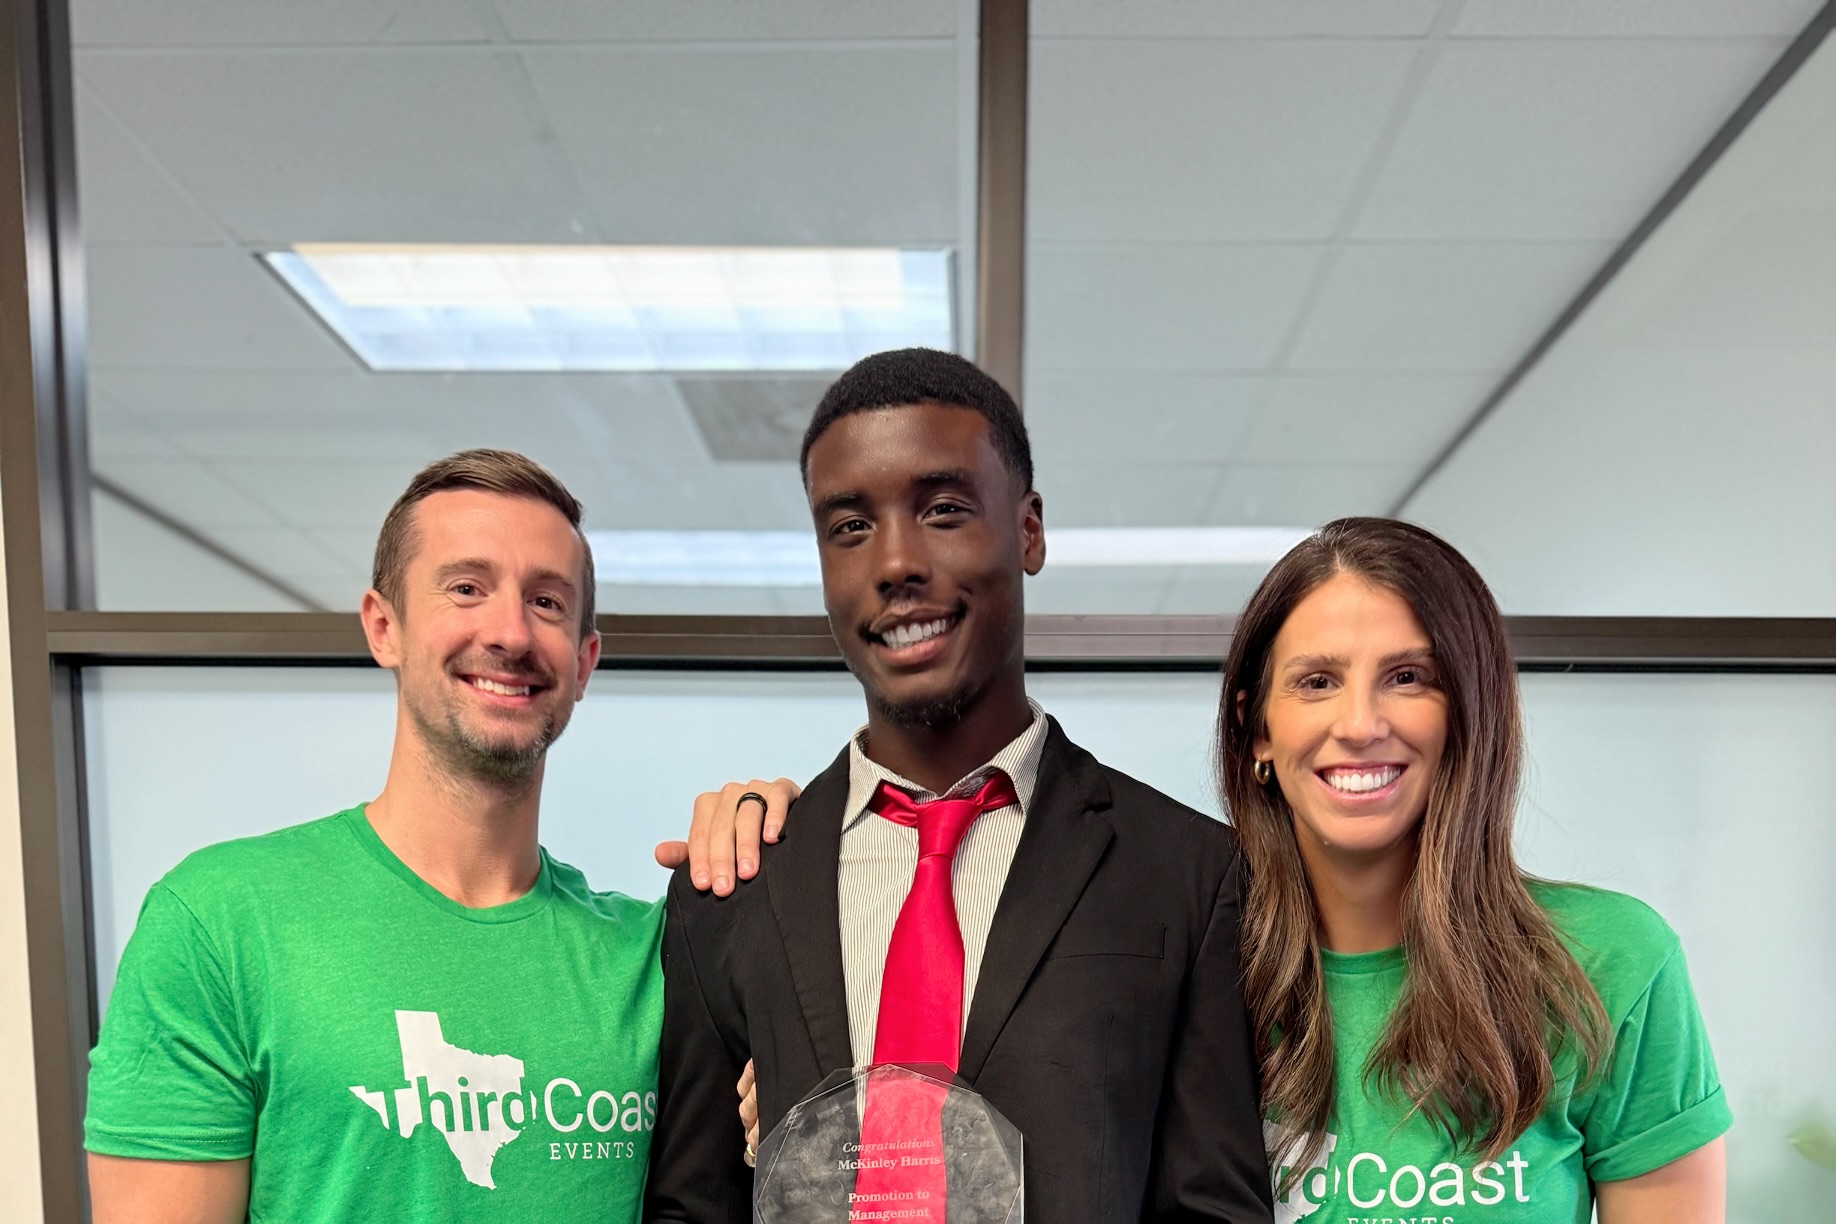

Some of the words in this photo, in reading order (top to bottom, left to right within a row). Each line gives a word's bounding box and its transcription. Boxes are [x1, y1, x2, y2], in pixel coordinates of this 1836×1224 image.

[364, 1076, 531, 1132] Third
[544, 1077, 658, 1132] Coas
[550, 1141, 634, 1160] EVENTS
[842, 1138, 935, 1154] Congratulations
[838, 1157, 898, 1170] McKinley
[901, 1155, 941, 1167] Harris
[1346, 1151, 1530, 1208] Coast
[848, 1190, 913, 1203] Promotion
[917, 1190, 930, 1200] to
[848, 1207, 930, 1221] Management
